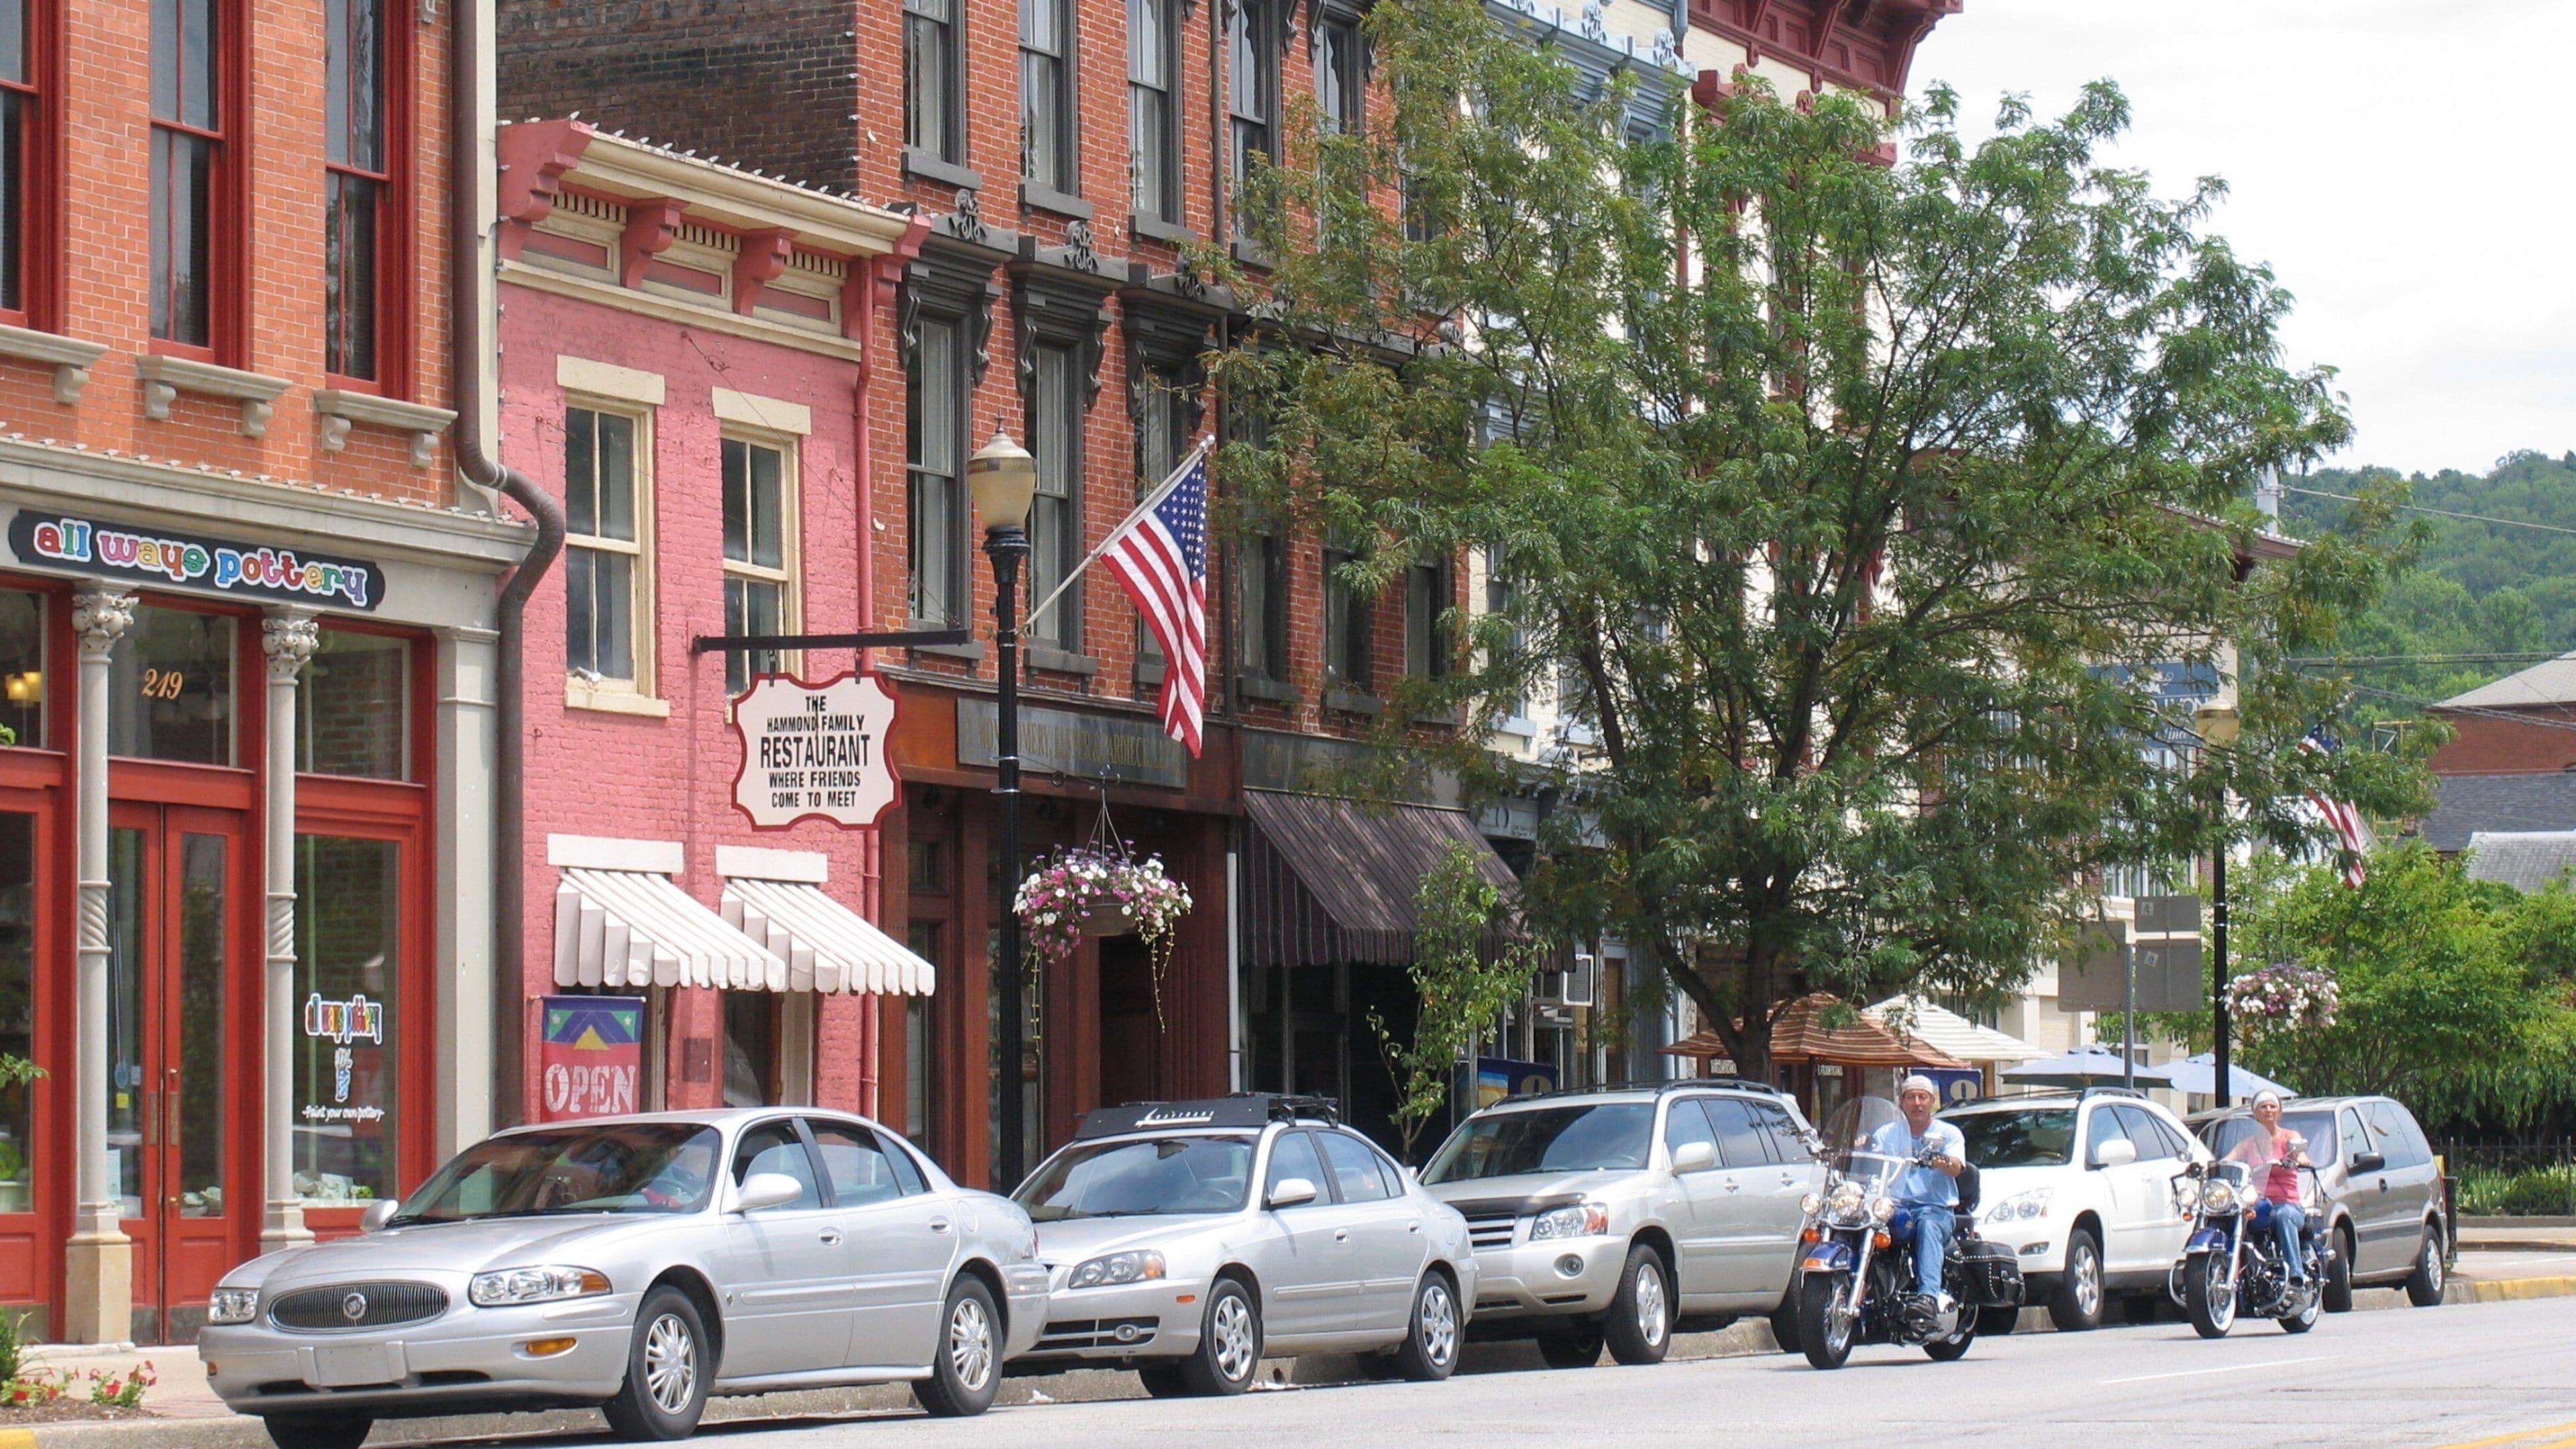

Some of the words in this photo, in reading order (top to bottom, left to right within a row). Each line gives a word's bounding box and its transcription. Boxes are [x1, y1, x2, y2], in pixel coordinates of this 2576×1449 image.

[34, 519, 92, 564] all
[97, 531, 209, 582] ways
[214, 547, 368, 606] pottery
[142, 668, 182, 699] 219
[806, 695, 826, 712] THE
[767, 716, 818, 733] HAMMOND
[822, 715, 865, 731] FAMILY
[761, 735, 870, 768] RESTAURANT
[769, 772, 804, 788] WHERE
[810, 771, 861, 787] FRIENDS
[771, 792, 800, 808] COME
[808, 792, 821, 807] TO
[828, 791, 856, 807] MEET
[344, 995, 382, 1044] pottery
[545, 1063, 635, 1113] OPEN
